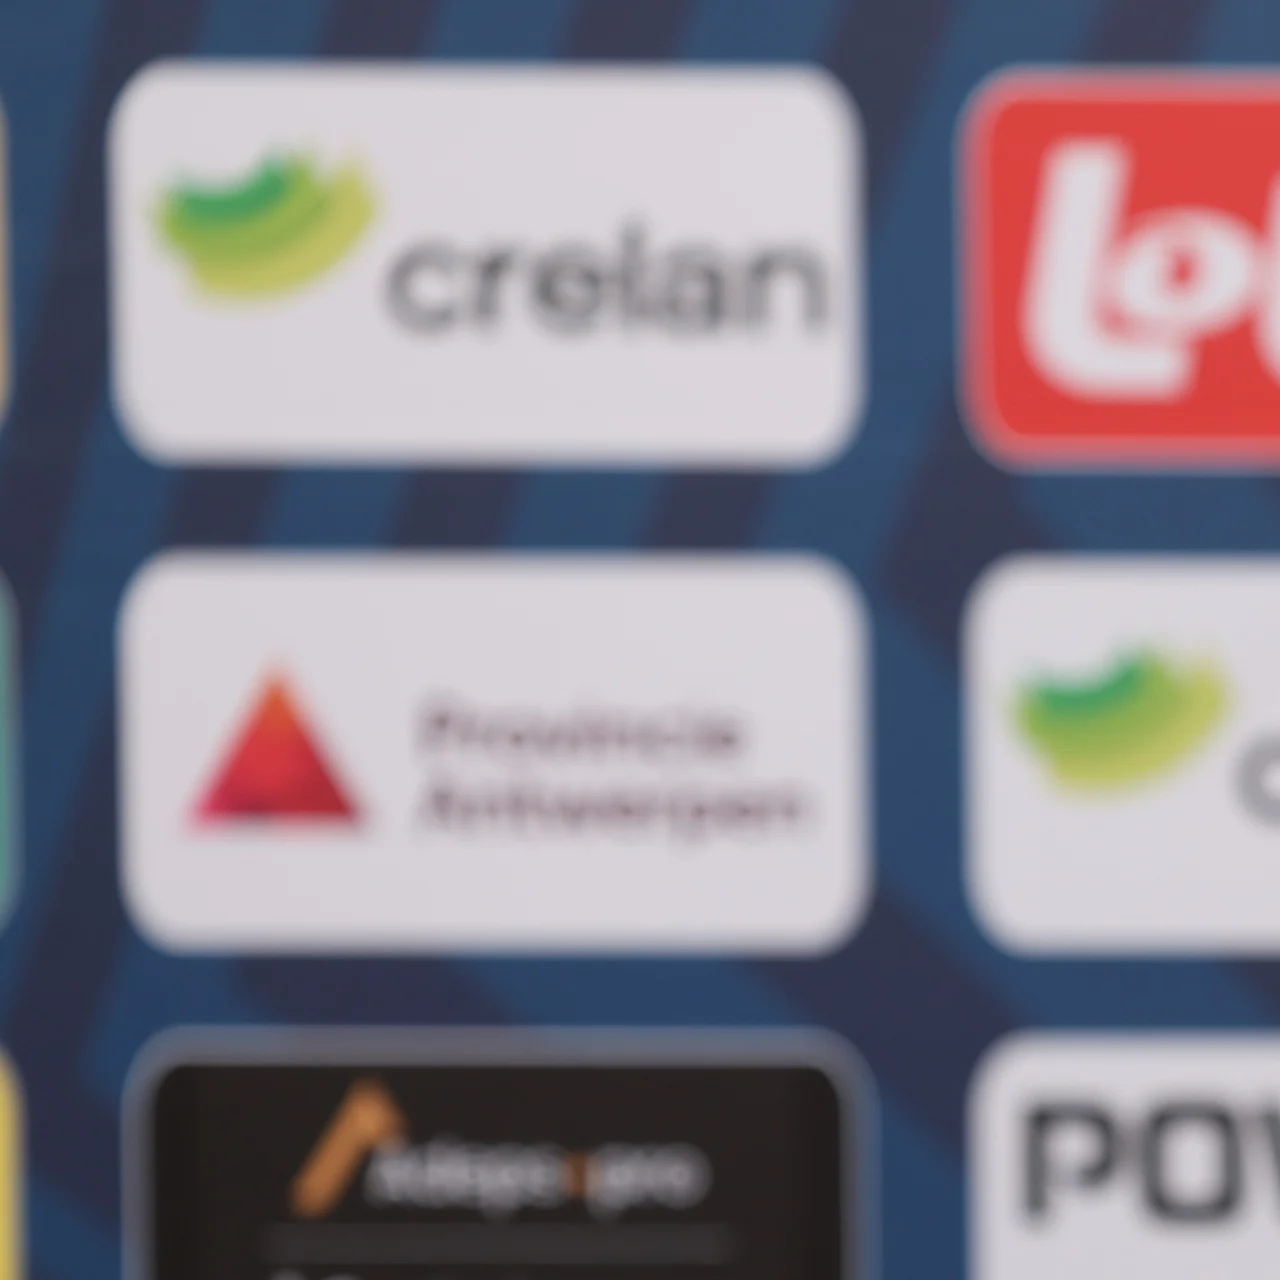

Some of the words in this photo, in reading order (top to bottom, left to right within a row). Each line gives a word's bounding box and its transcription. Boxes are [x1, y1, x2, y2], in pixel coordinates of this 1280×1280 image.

[386, 222, 830, 335] crelan
[418, 697, 744, 760] Provincie
[420, 776, 808, 850] Antwerpen
